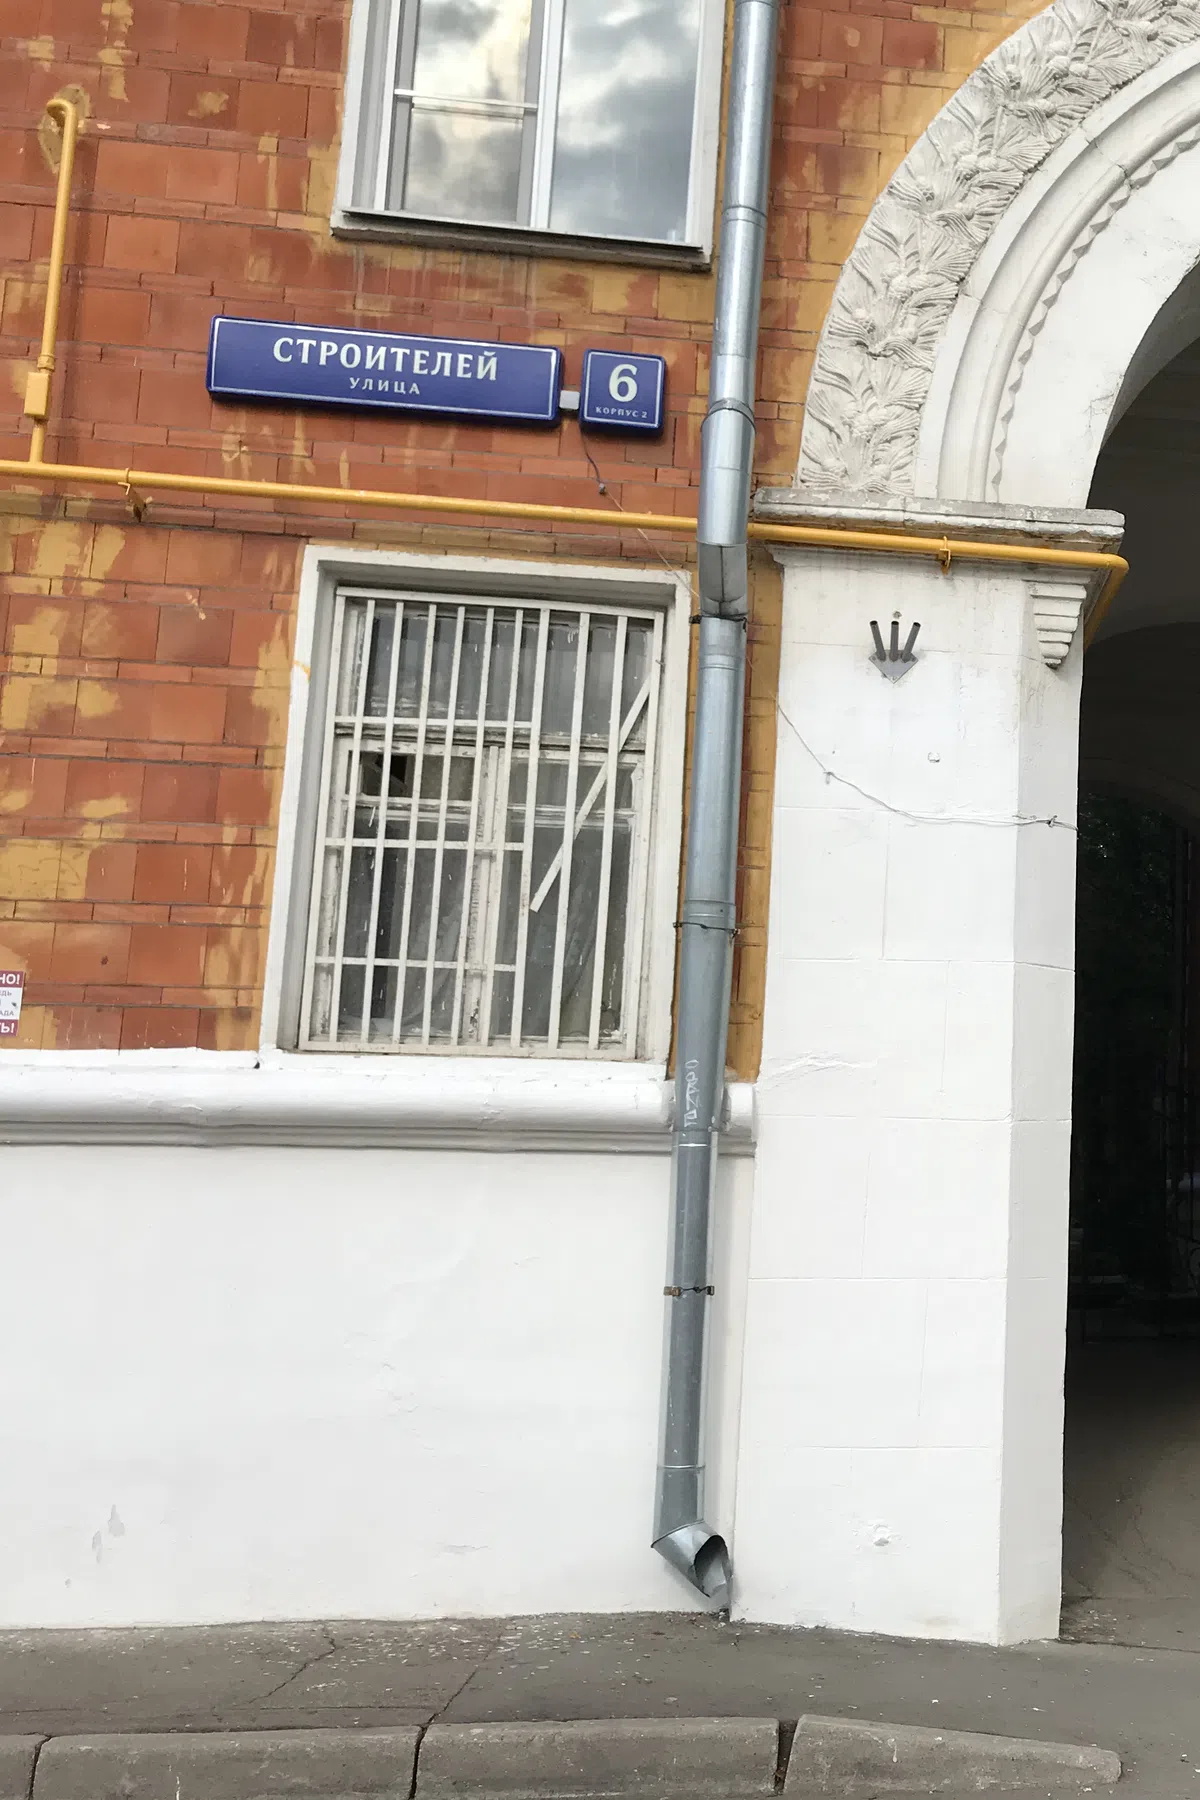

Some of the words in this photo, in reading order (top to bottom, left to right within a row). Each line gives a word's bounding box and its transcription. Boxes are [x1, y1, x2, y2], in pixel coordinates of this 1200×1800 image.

[273, 337, 498, 381] СТРОИТЕЛЕЙ
[349, 377, 420, 395] УЛИЦА
[609, 363, 638, 402] 6
[595, 406, 639, 418] КОРПУС
[641, 411, 648, 419] 2
